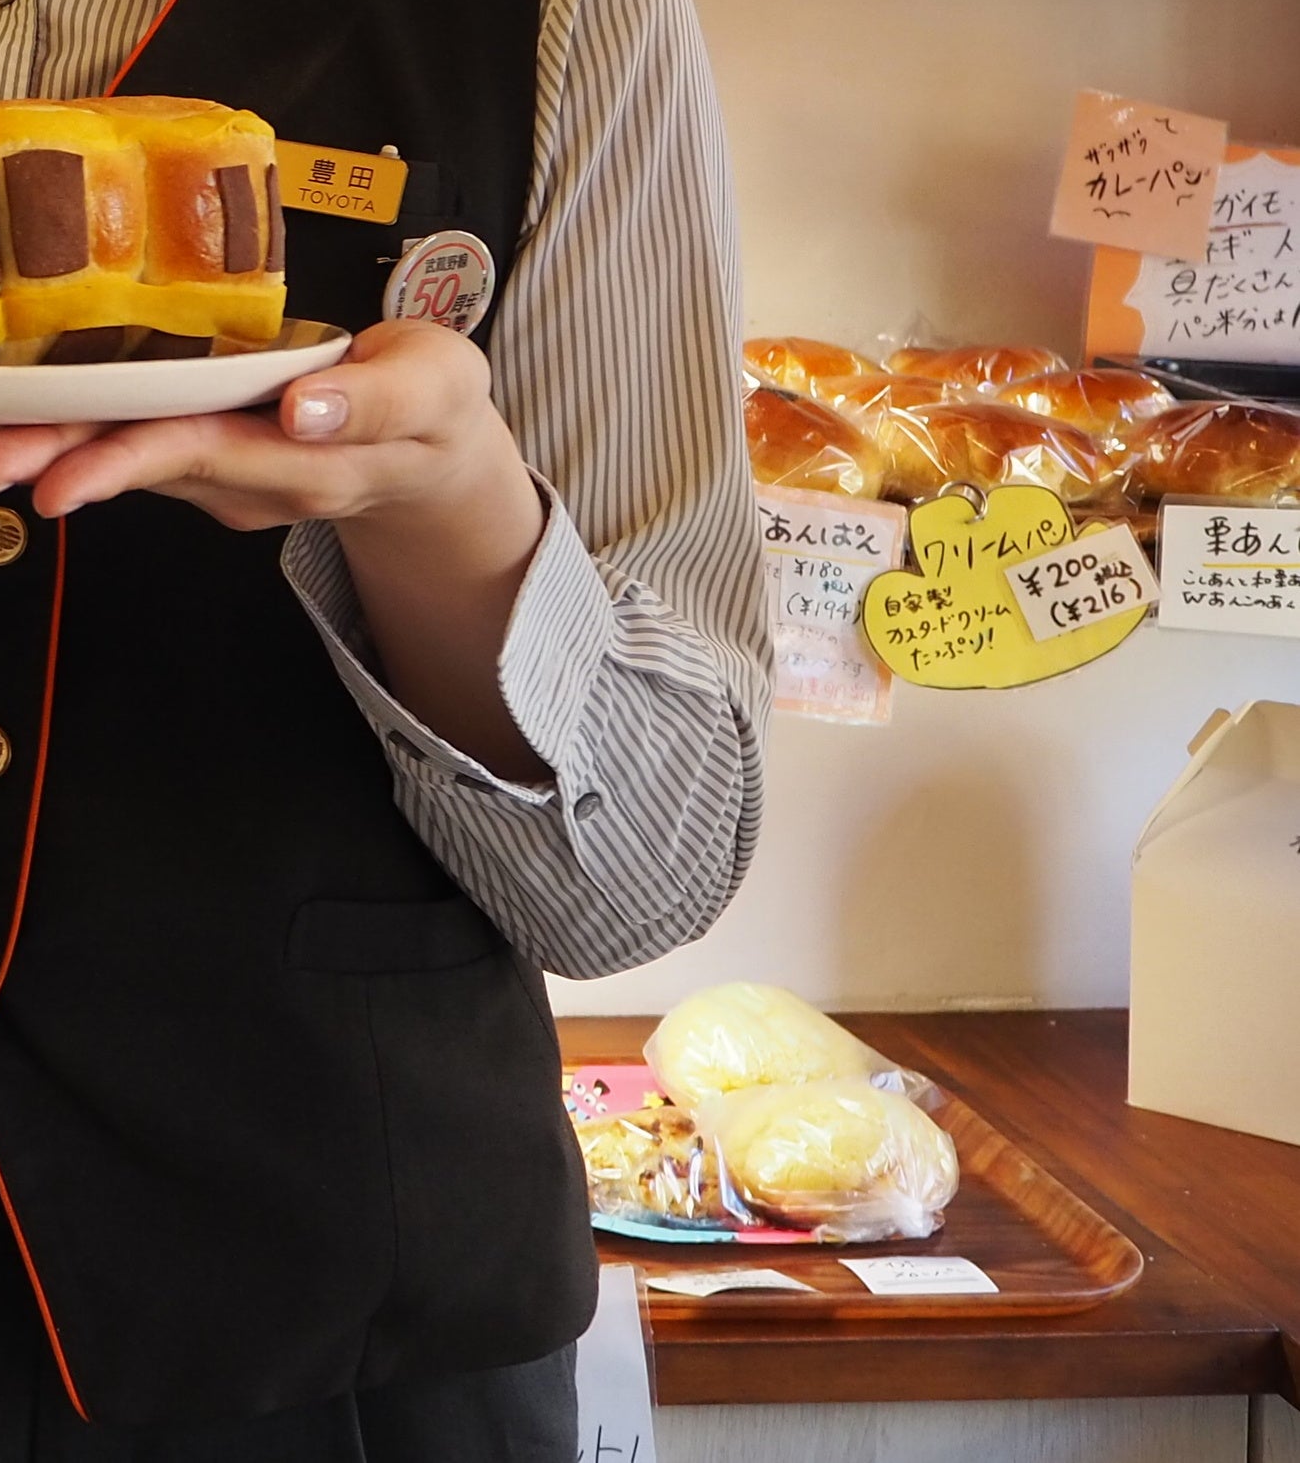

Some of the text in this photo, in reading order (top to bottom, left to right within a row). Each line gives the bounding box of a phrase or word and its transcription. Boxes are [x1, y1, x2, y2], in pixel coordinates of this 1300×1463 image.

[1084, 128, 1148, 165] ザクザク
[308, 158, 374, 190] 豊田
[1085, 160, 1205, 202] カレーパン
[299, 188, 375, 213] TOYOTA
[925, 519, 1067, 577] クリームパン
[794, 558, 843, 578] ¥180
[885, 587, 953, 617] 自家製
[887, 605, 1012, 645] カスタードクリーム
